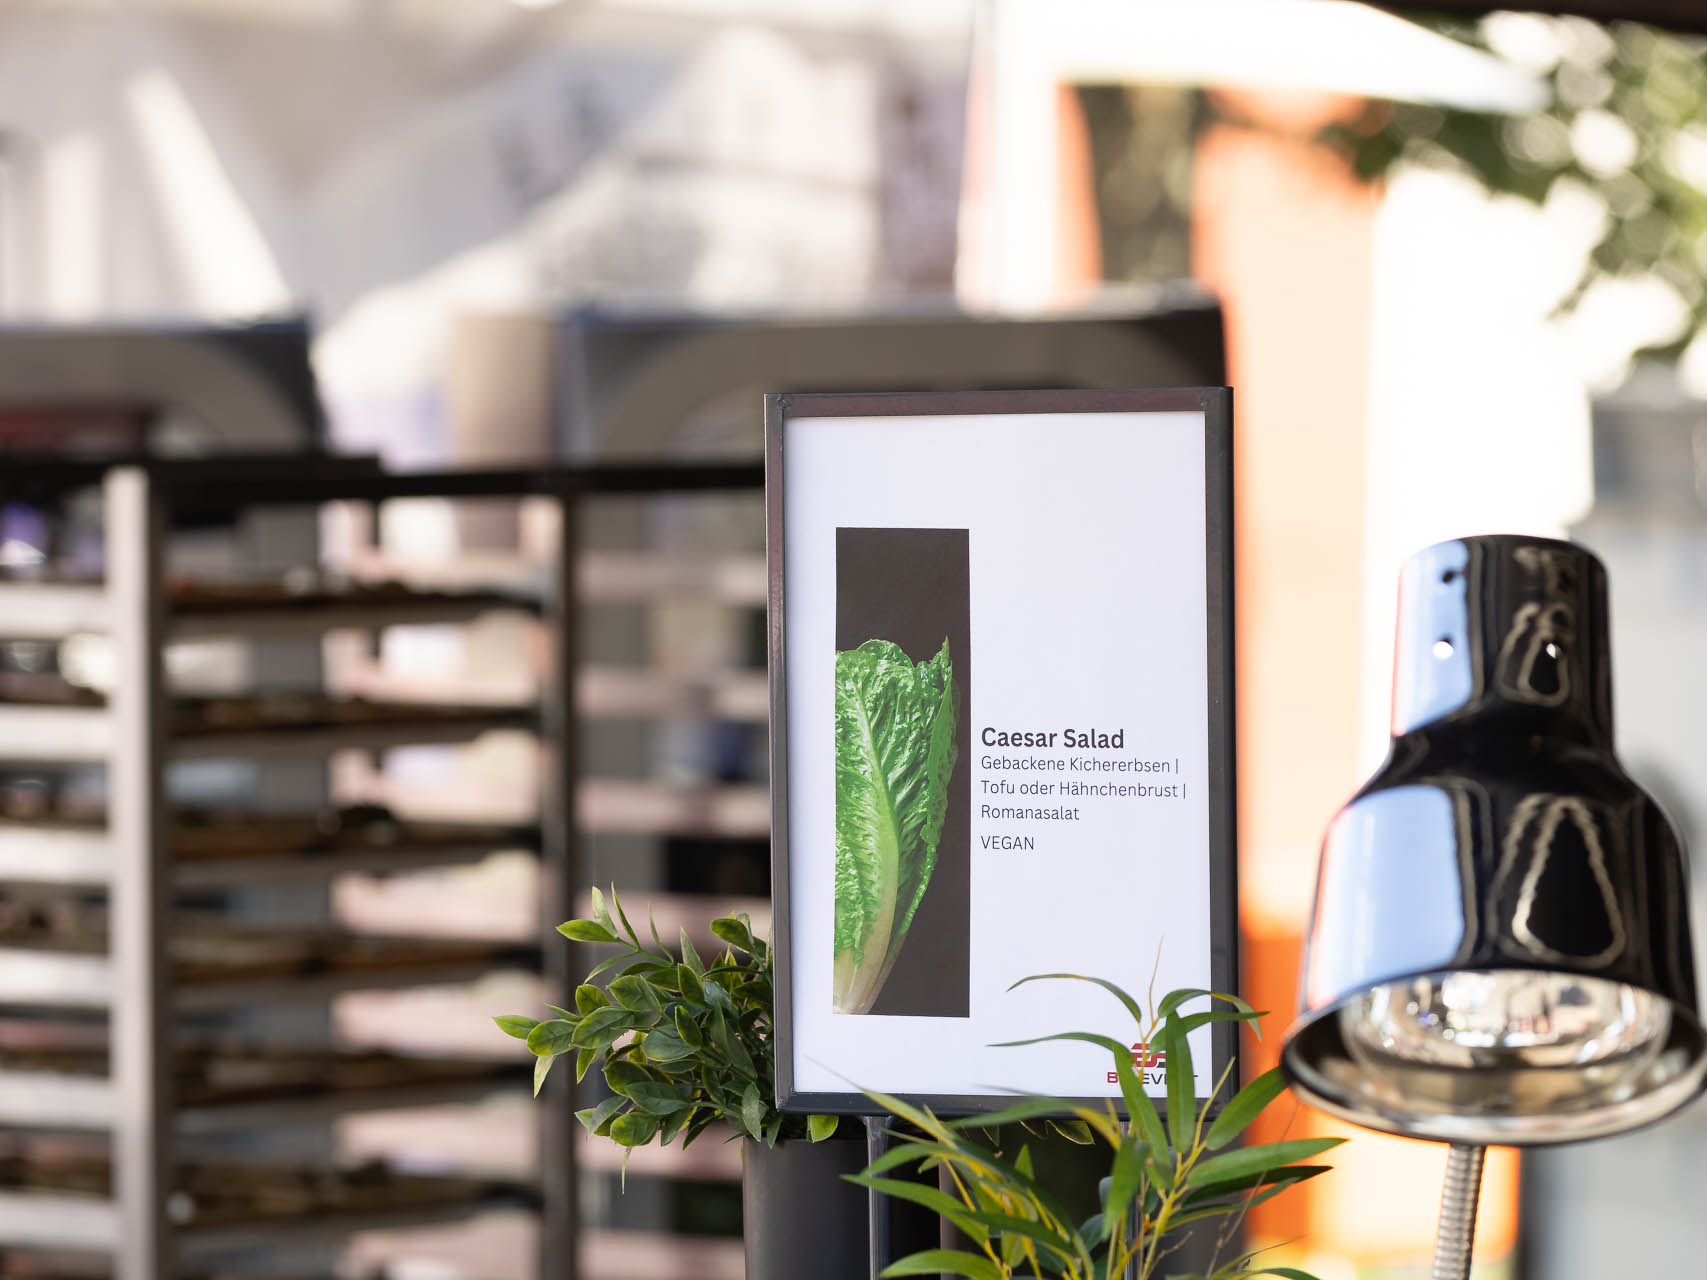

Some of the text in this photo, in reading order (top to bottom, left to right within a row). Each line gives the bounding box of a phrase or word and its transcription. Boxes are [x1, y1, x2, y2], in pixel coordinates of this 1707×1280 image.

[982, 727, 1124, 749] Caesar Salad
[982, 755, 1064, 770] Gebackene
[1070, 757, 1169, 772] Kichererbsen
[981, 780, 1014, 794] Tofu
[1020, 780, 1055, 795] oder
[1060, 781, 1178, 797] Hähnchenbrust
[982, 805, 1079, 820] Romanasalat
[981, 836, 1034, 850] VEGAN
